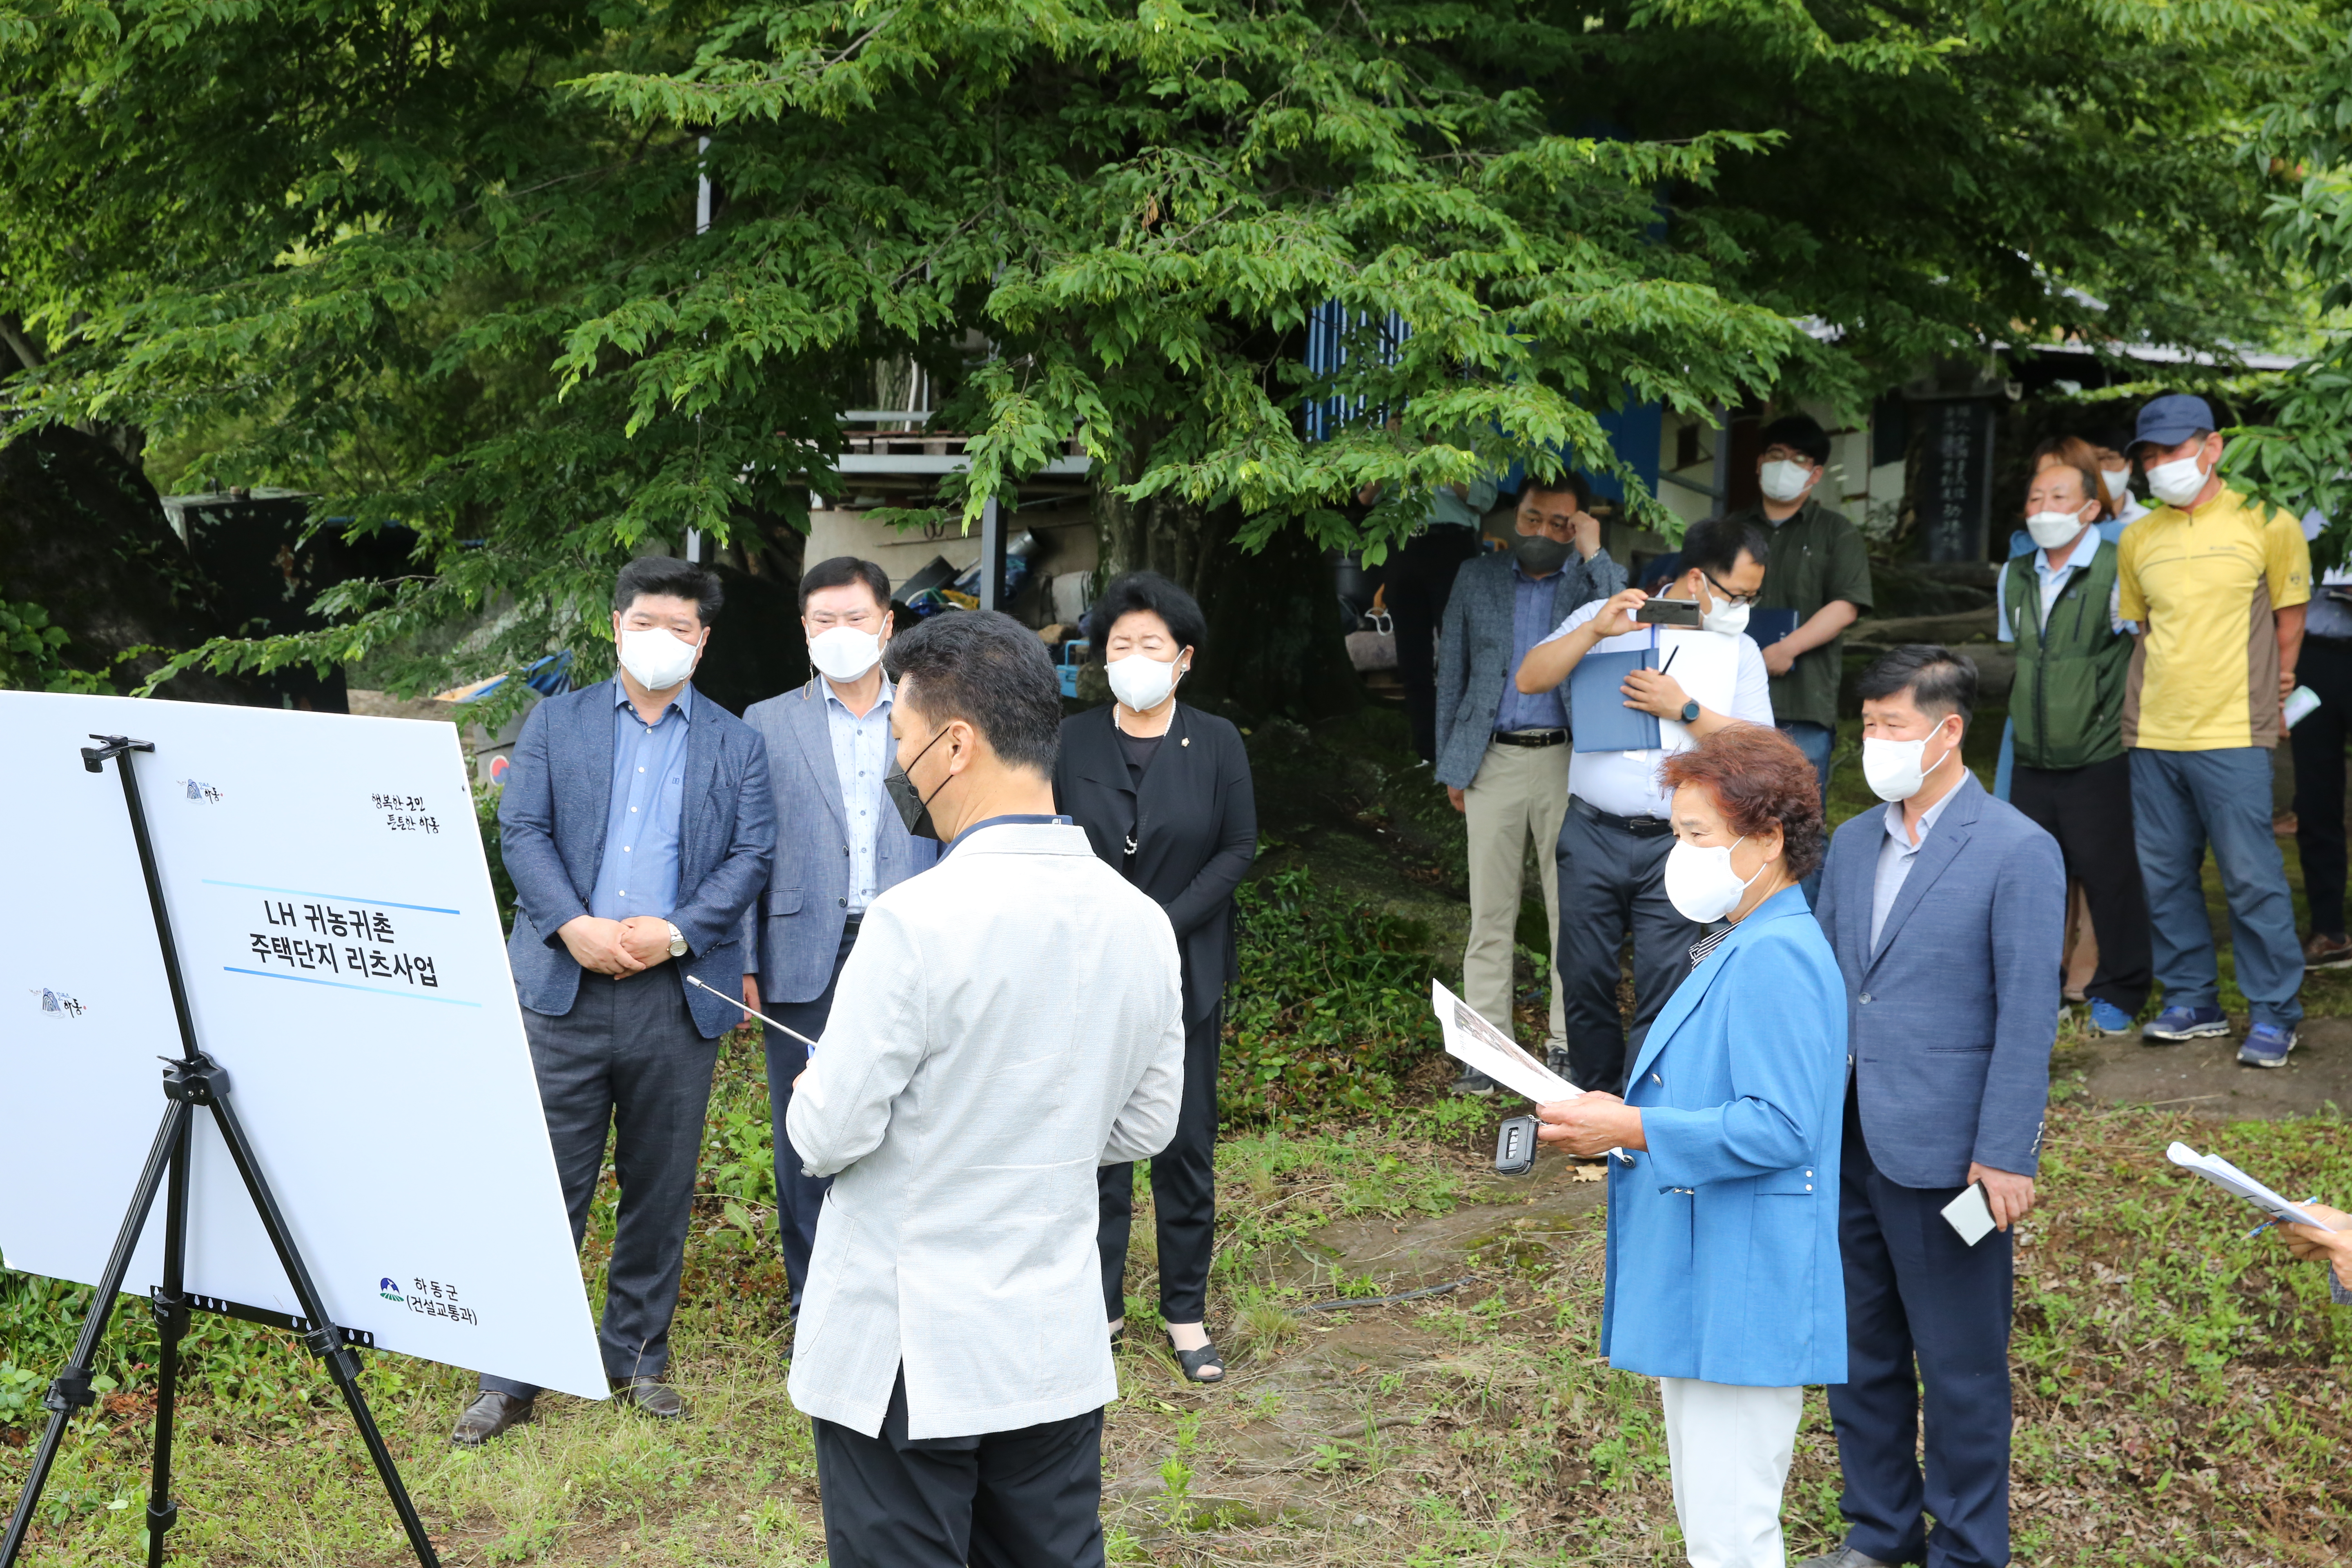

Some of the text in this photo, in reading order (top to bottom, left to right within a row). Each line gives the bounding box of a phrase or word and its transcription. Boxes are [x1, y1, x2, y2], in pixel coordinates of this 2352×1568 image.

[205, 787, 220, 804] 하동
[371, 793, 425, 811] 행복한 군민
[387, 814, 440, 834] 튼튼한 하동
[264, 900, 394, 944] LH 귀농귀촌
[249, 933, 439, 987] 주택단지 리츠사업
[64, 998, 82, 1018] 하동
[406, 1295, 477, 1326] (건설교통과)
